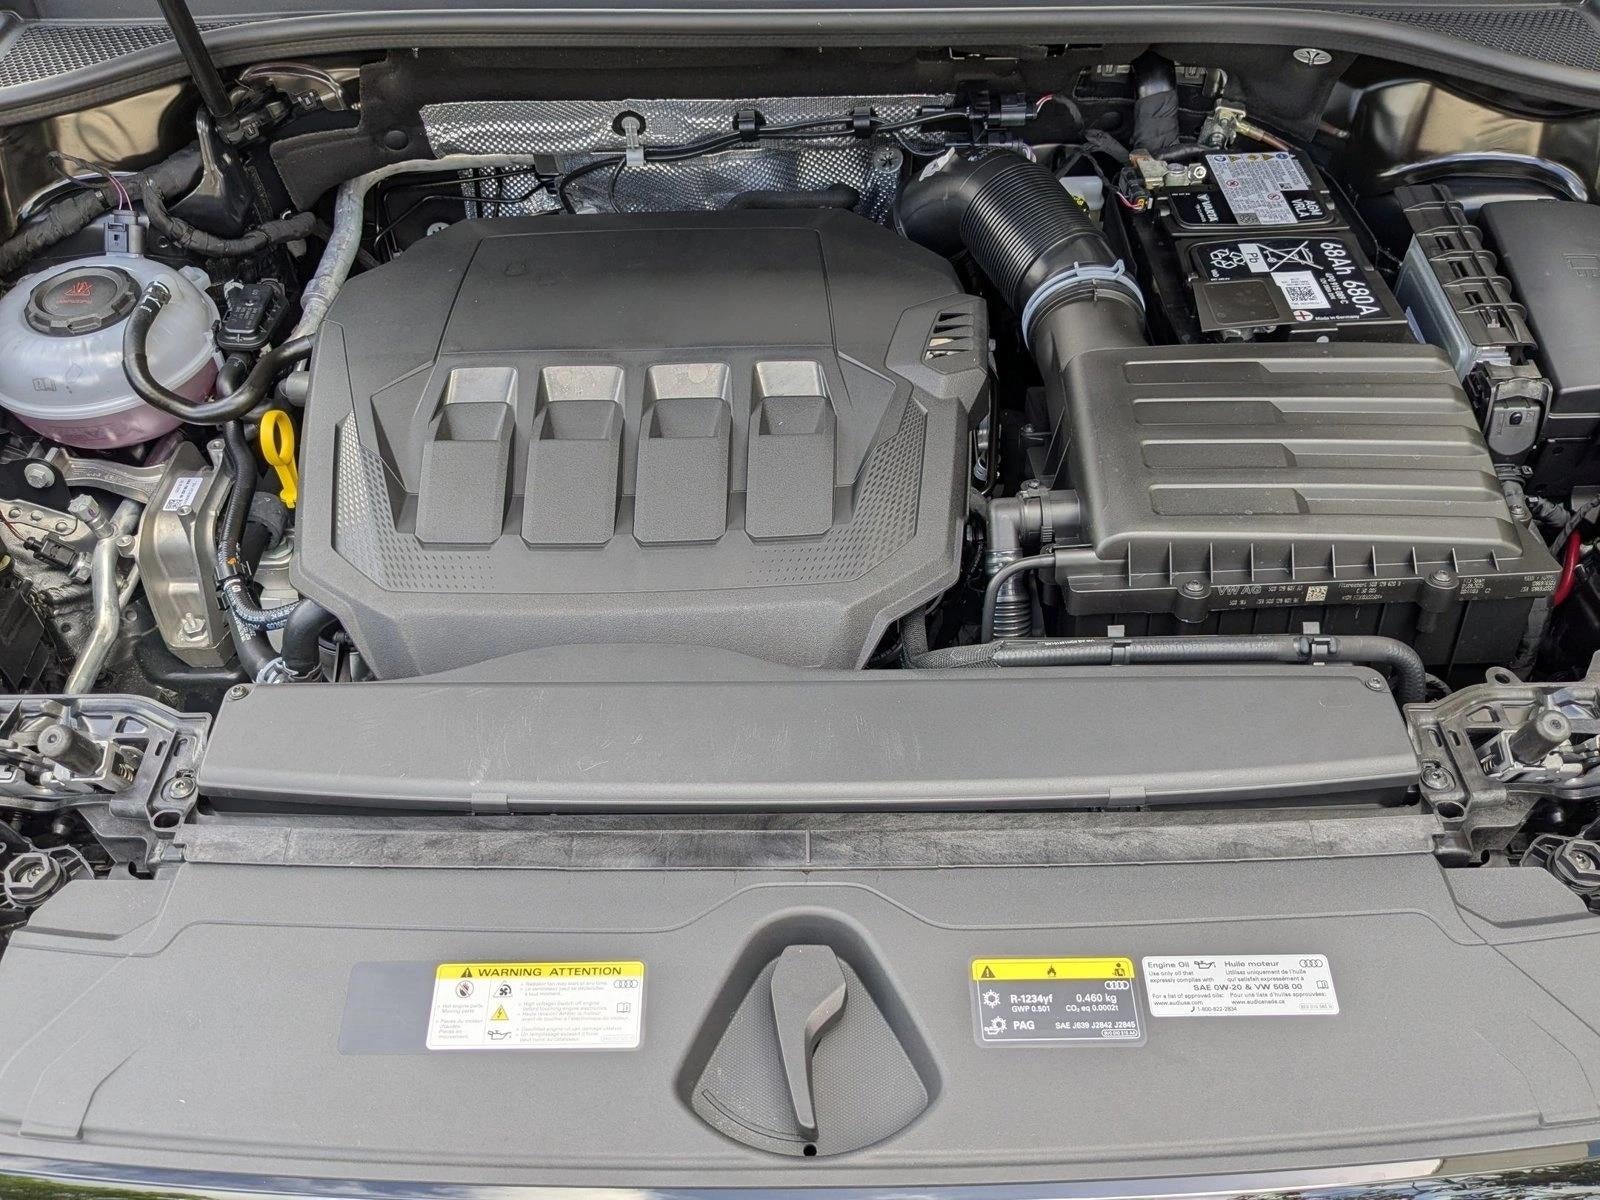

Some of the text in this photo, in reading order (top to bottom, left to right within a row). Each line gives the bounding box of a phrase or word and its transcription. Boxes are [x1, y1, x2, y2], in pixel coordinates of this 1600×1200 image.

[1202, 200, 1219, 222] VARTA
[1292, 198, 1310, 218] VRLA
[1246, 252, 1262, 264] Pb
[1320, 242, 1381, 316] 68Ah 680A
[1217, 584, 1262, 596] VW AG
[478, 966, 622, 976] WARNING ATTENTION
[1010, 993, 1117, 1004] R-1234yf 0.460 kg
[1013, 1020, 1035, 1030] PAG
